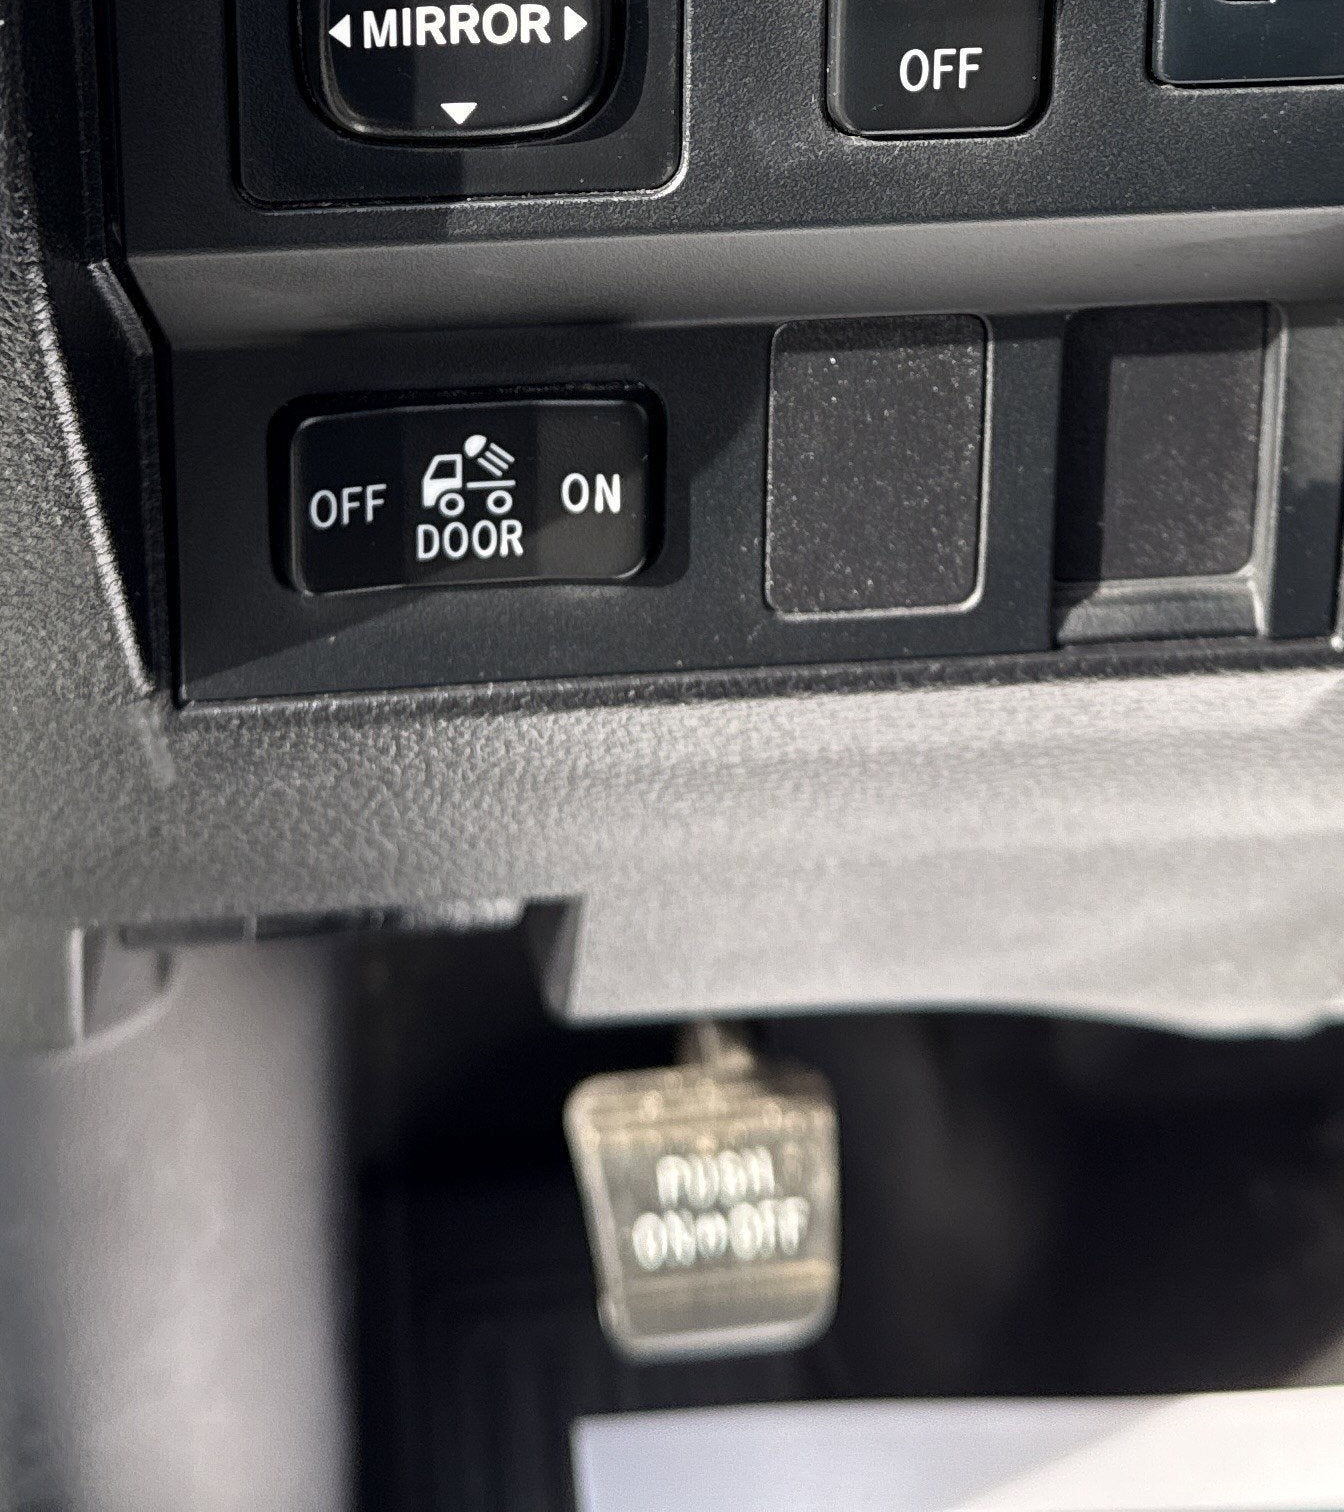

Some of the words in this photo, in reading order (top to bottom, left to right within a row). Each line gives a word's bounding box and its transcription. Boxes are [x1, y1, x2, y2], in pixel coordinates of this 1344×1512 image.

[363, 3, 551, 48] MIRROR
[900, 47, 982, 92] OFF
[311, 484, 386, 528] OFF
[562, 473, 620, 513] ON
[417, 519, 523, 560] DOOR
